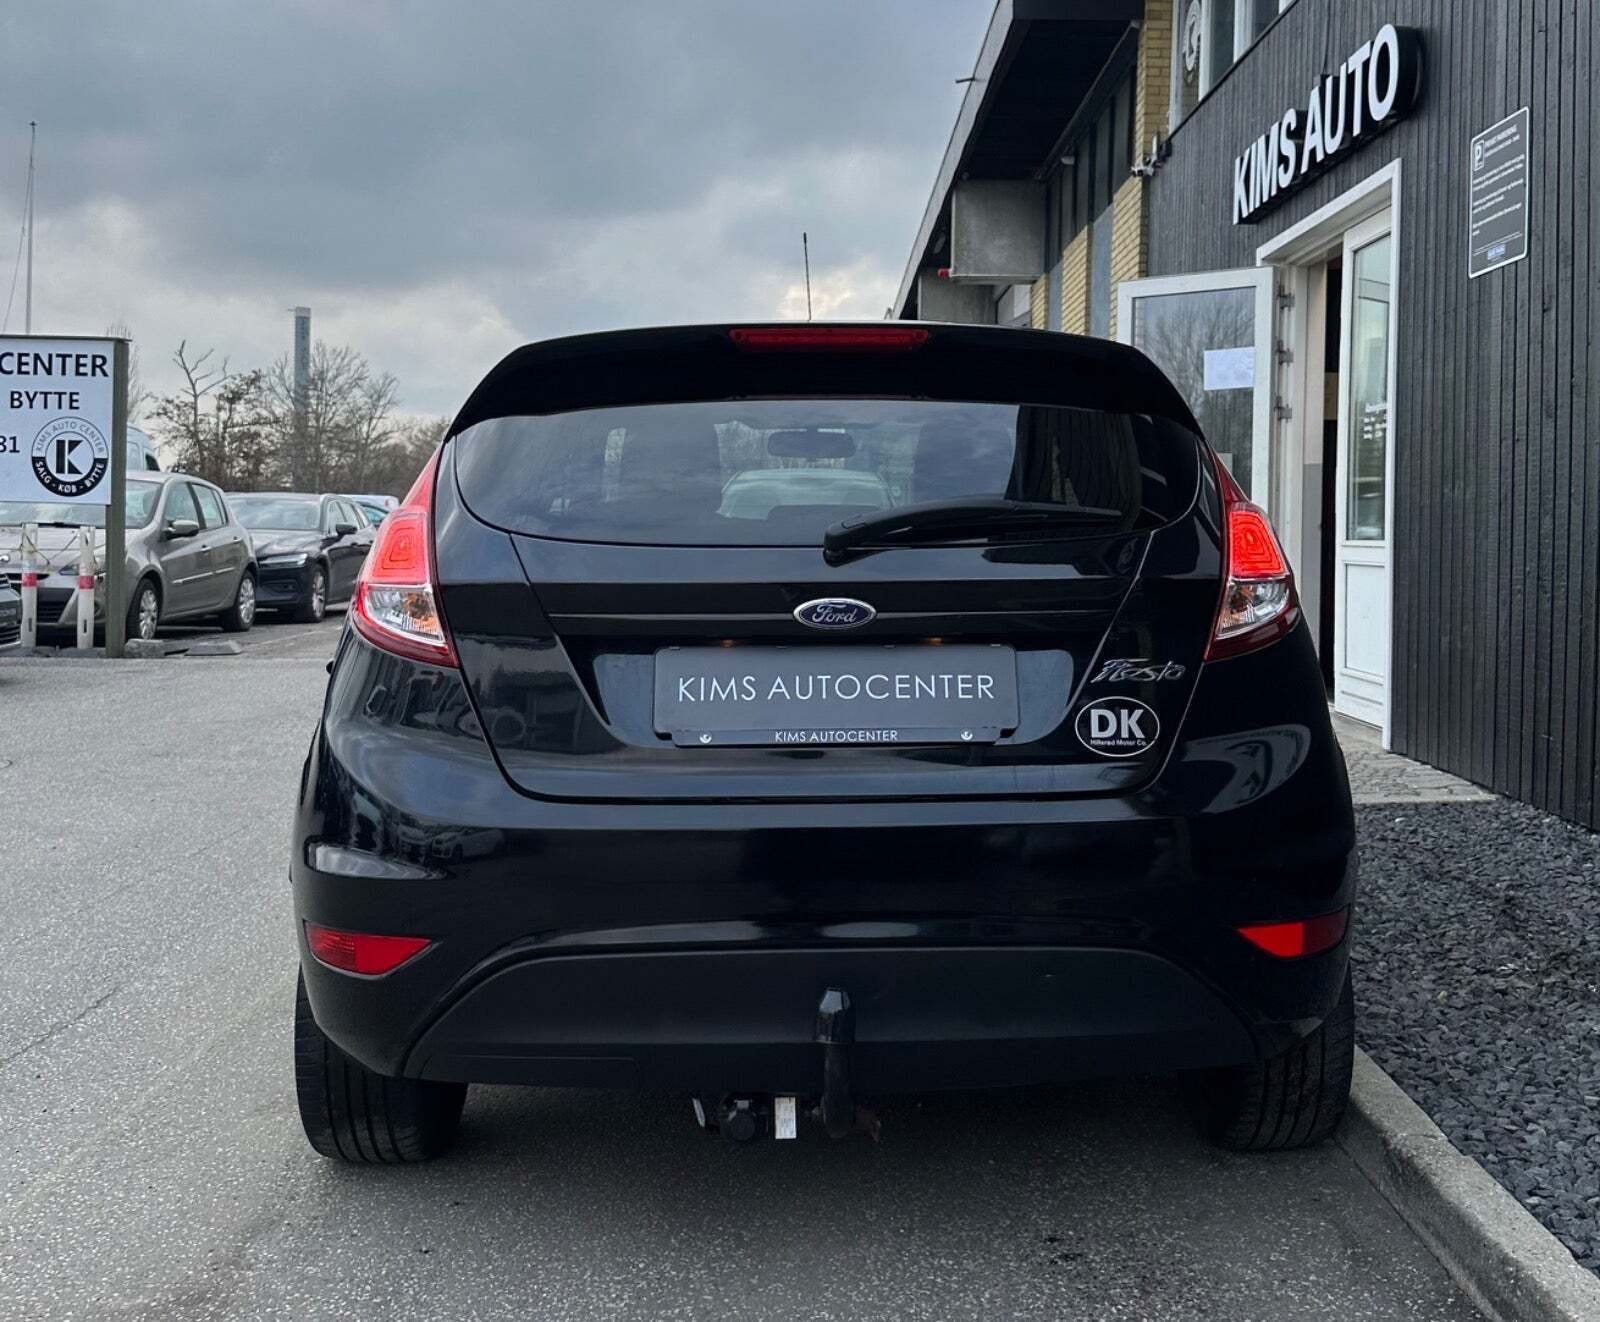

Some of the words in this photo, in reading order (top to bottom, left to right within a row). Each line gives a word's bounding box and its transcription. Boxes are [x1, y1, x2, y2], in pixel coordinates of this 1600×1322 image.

[1233, 108, 1297, 225] KIMS
[1300, 23, 1399, 175] AUTO
[0, 352, 109, 377] CENTER
[10, 391, 80, 410] BYTTE
[52, 421, 78, 433] AUTO
[56, 439, 83, 474] K
[36, 461, 51, 484] SALG
[85, 463, 105, 487] BYTTE
[811, 602, 857, 624] Ford
[1090, 658, 1187, 683] Fiesta
[678, 676, 757, 702] KIMS
[767, 674, 995, 700] AUTOCENTER
[1090, 708, 1145, 739] DK
[774, 731, 807, 743] KIMS
[809, 730, 898, 743] AUTOCENTER
